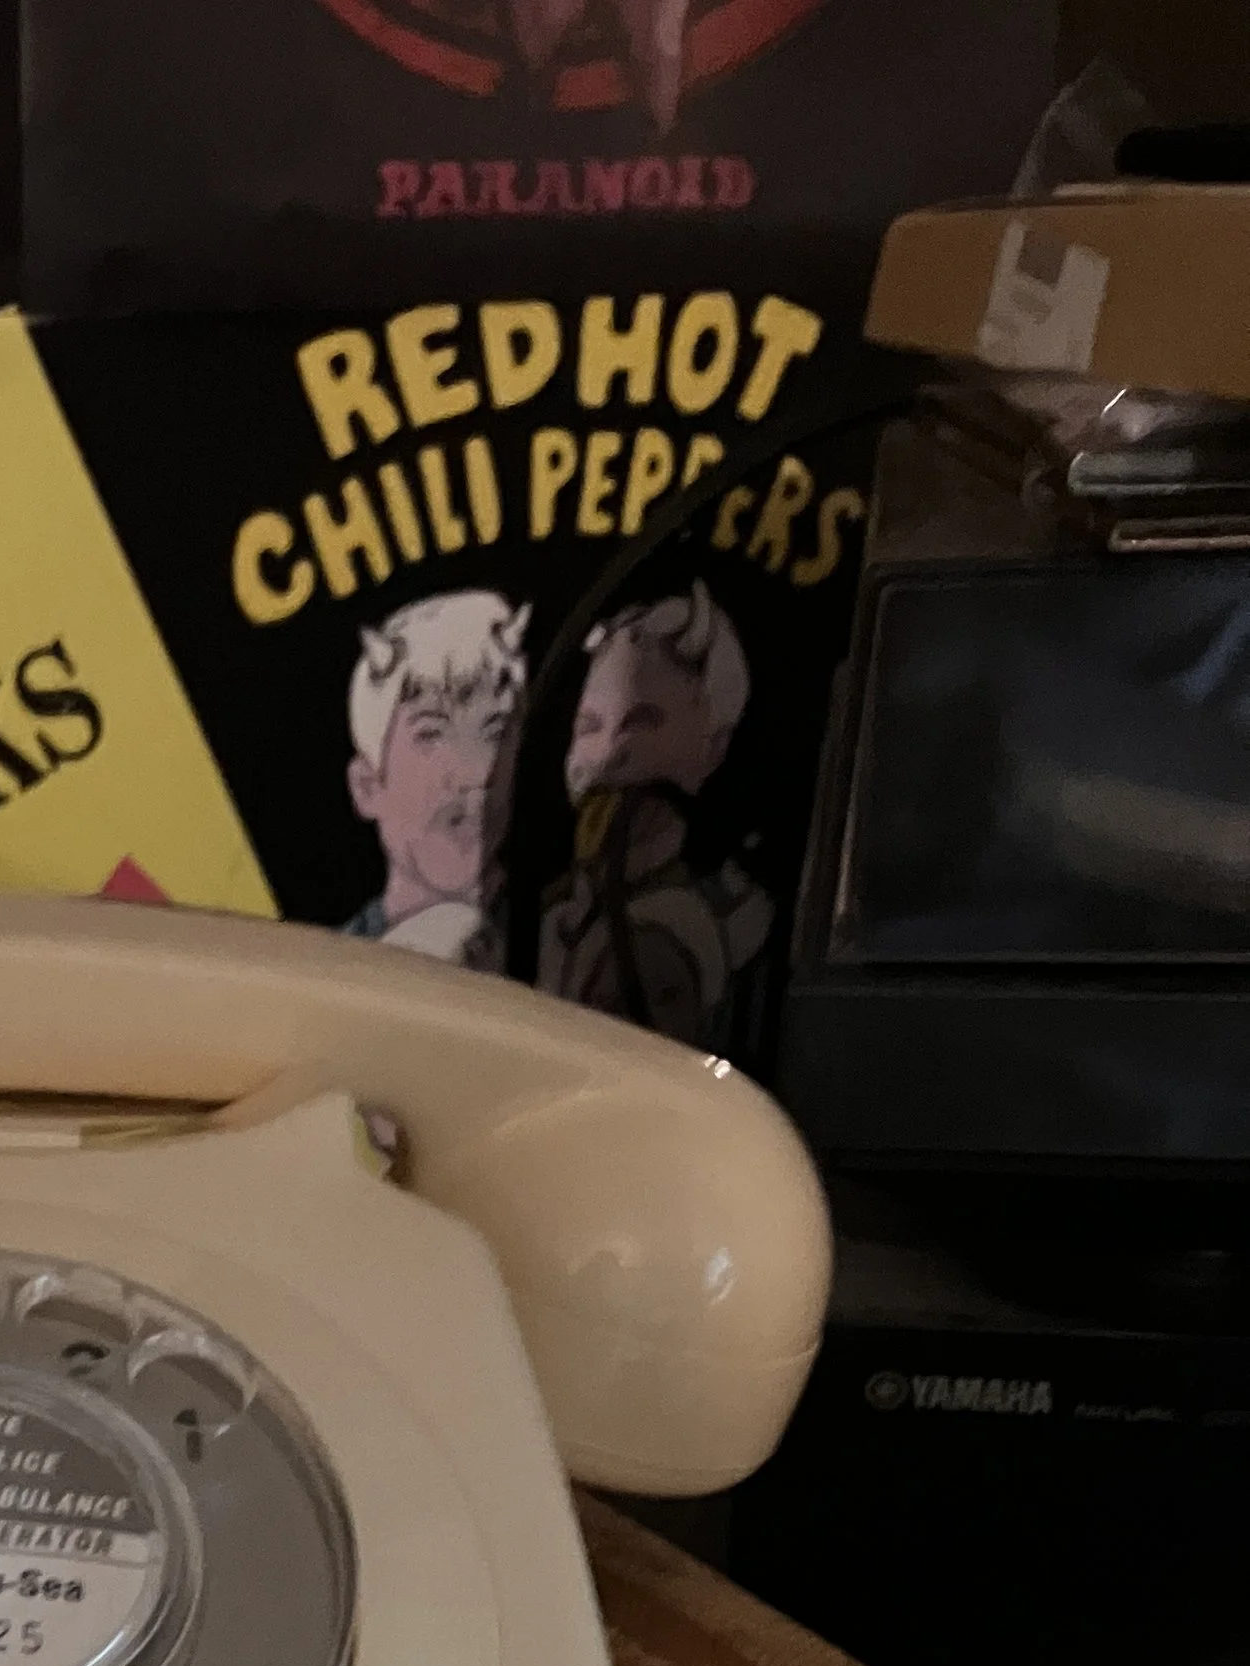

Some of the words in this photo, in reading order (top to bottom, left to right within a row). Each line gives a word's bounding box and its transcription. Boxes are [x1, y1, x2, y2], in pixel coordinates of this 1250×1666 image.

[376, 156, 756, 220] PARANOID
[295, 302, 563, 461] RED
[576, 290, 823, 422] HOT
[231, 434, 503, 627] CHILI
[912, 1374, 1052, 1416] YAMAHA
